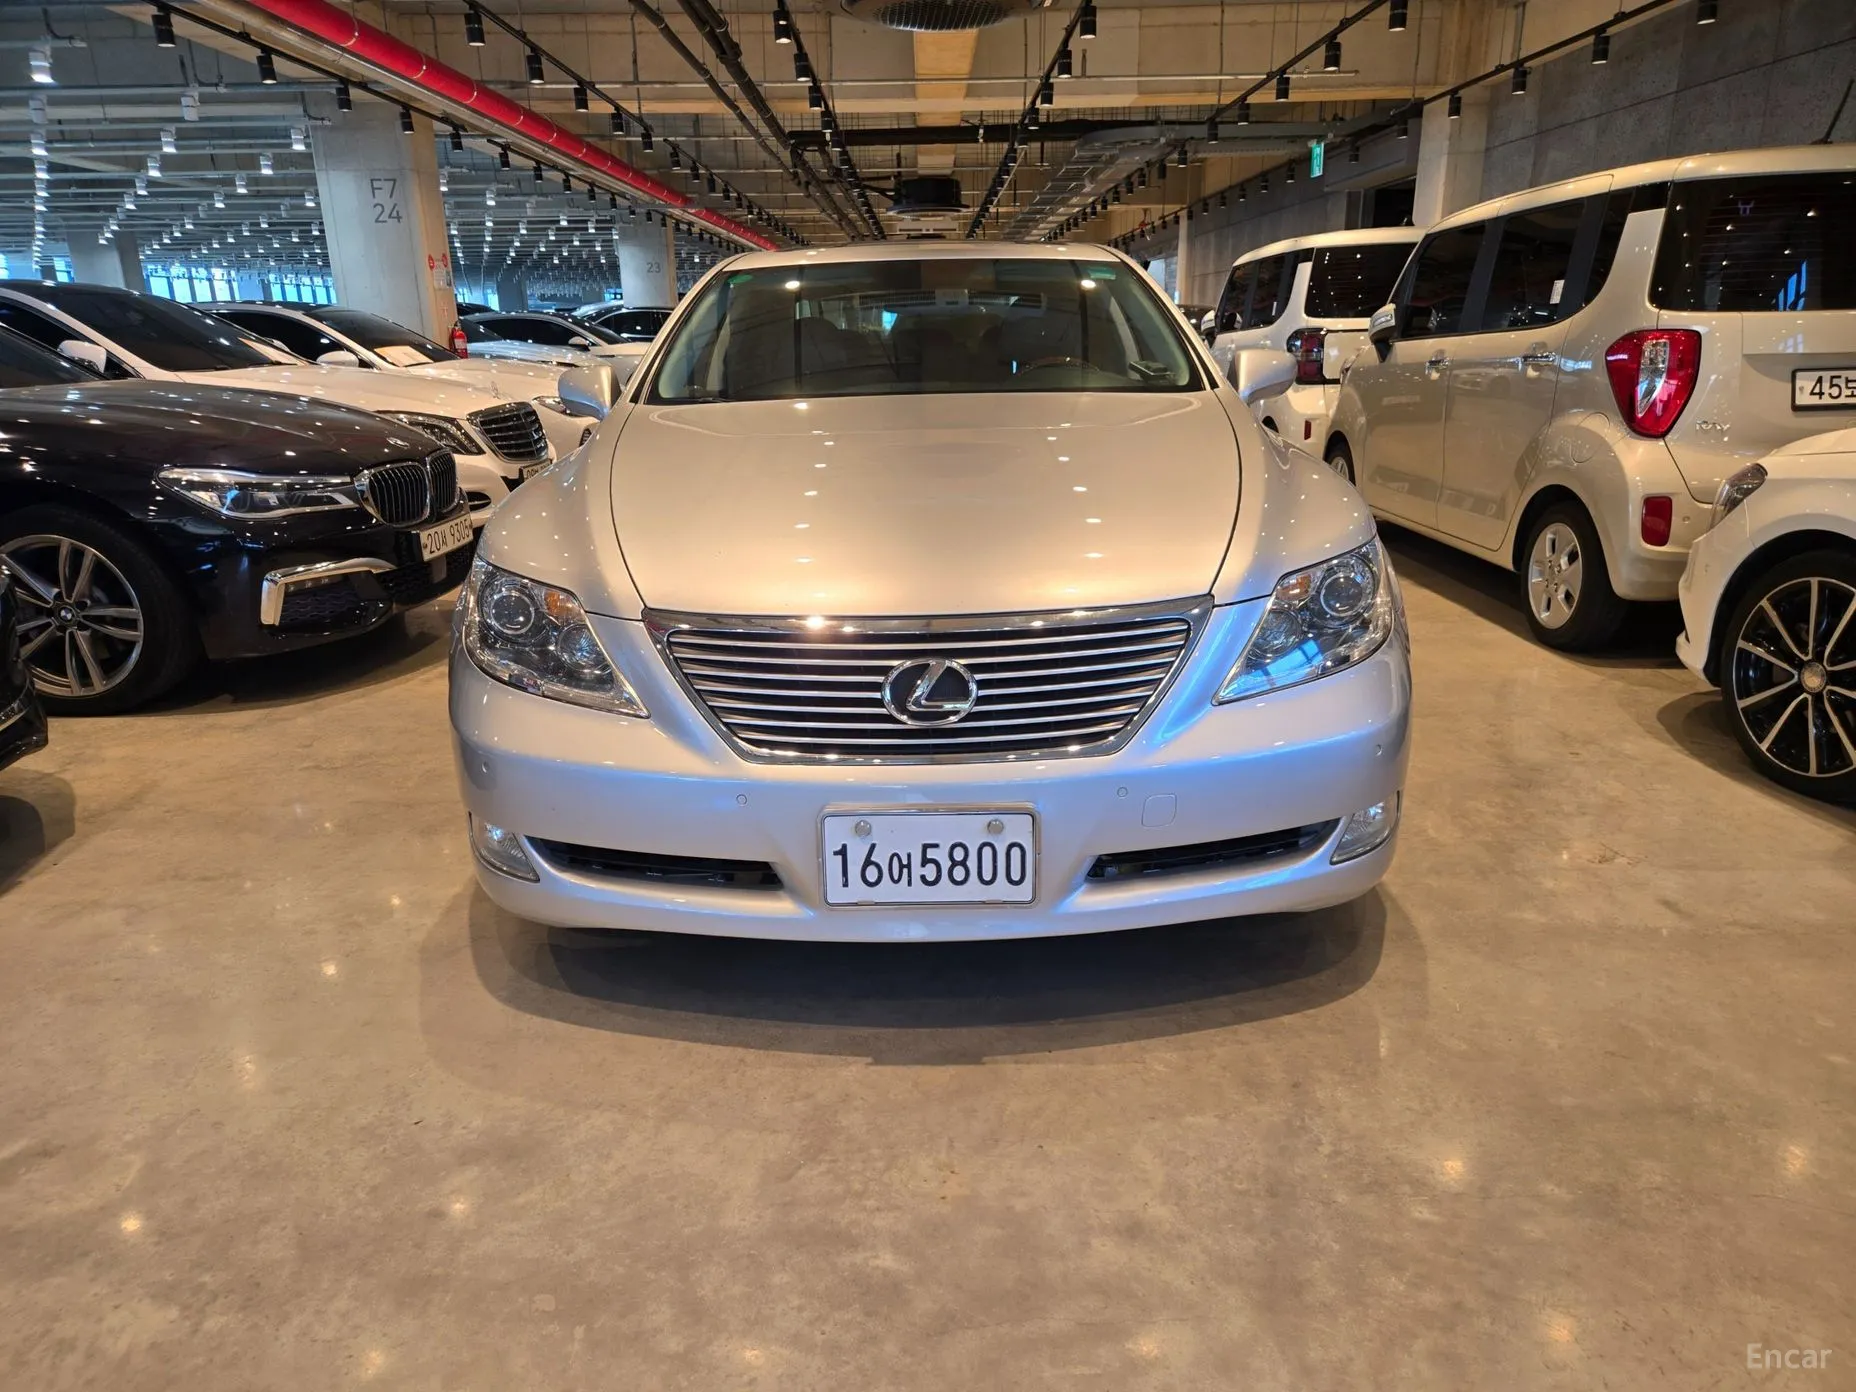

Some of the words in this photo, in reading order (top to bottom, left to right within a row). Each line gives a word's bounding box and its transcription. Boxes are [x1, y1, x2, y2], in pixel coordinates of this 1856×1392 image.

[370, 178, 397, 199] F7
[373, 203, 403, 224] 24
[646, 261, 662, 274] 23
[449, 518, 470, 545] 9305
[832, 841, 1027, 888] 16어5800
